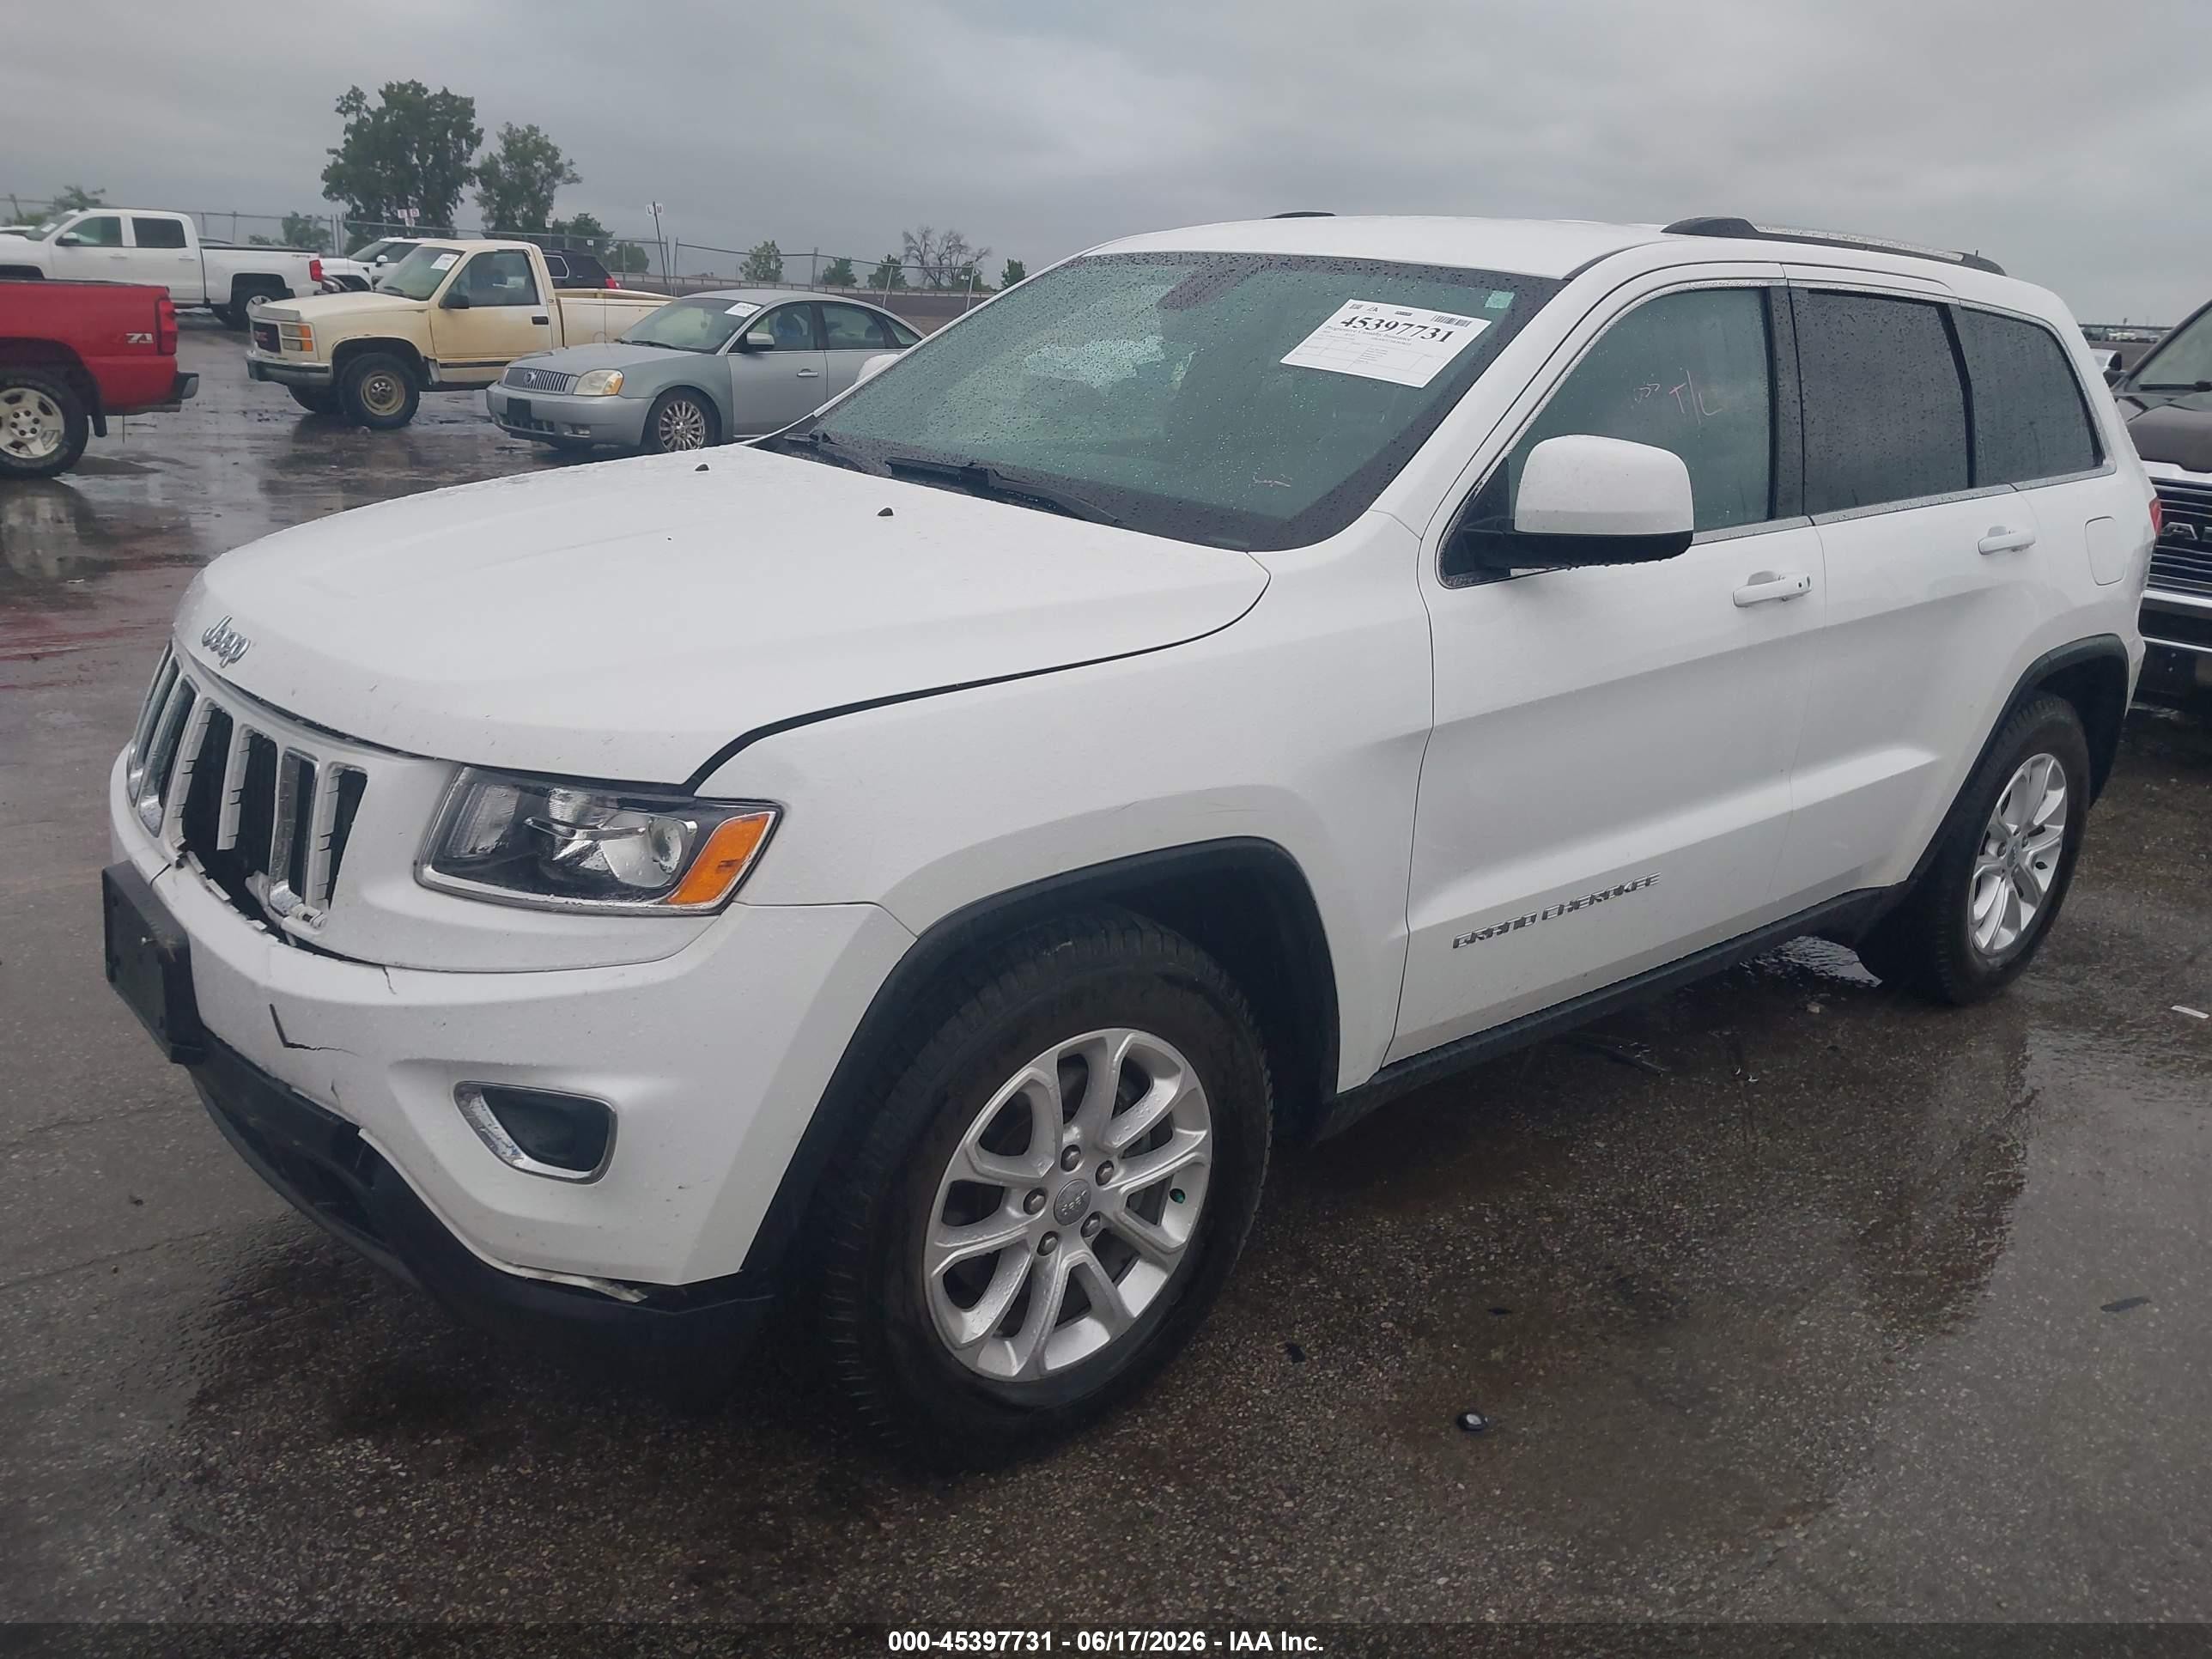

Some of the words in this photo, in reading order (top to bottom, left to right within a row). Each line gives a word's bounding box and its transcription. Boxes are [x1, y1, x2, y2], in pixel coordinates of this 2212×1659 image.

[1340, 315, 1455, 343] 45397731
[202, 615, 251, 669] Jeep
[1452, 912, 1538, 949] GRAND
[1541, 872, 1662, 921] CHEROKEE
